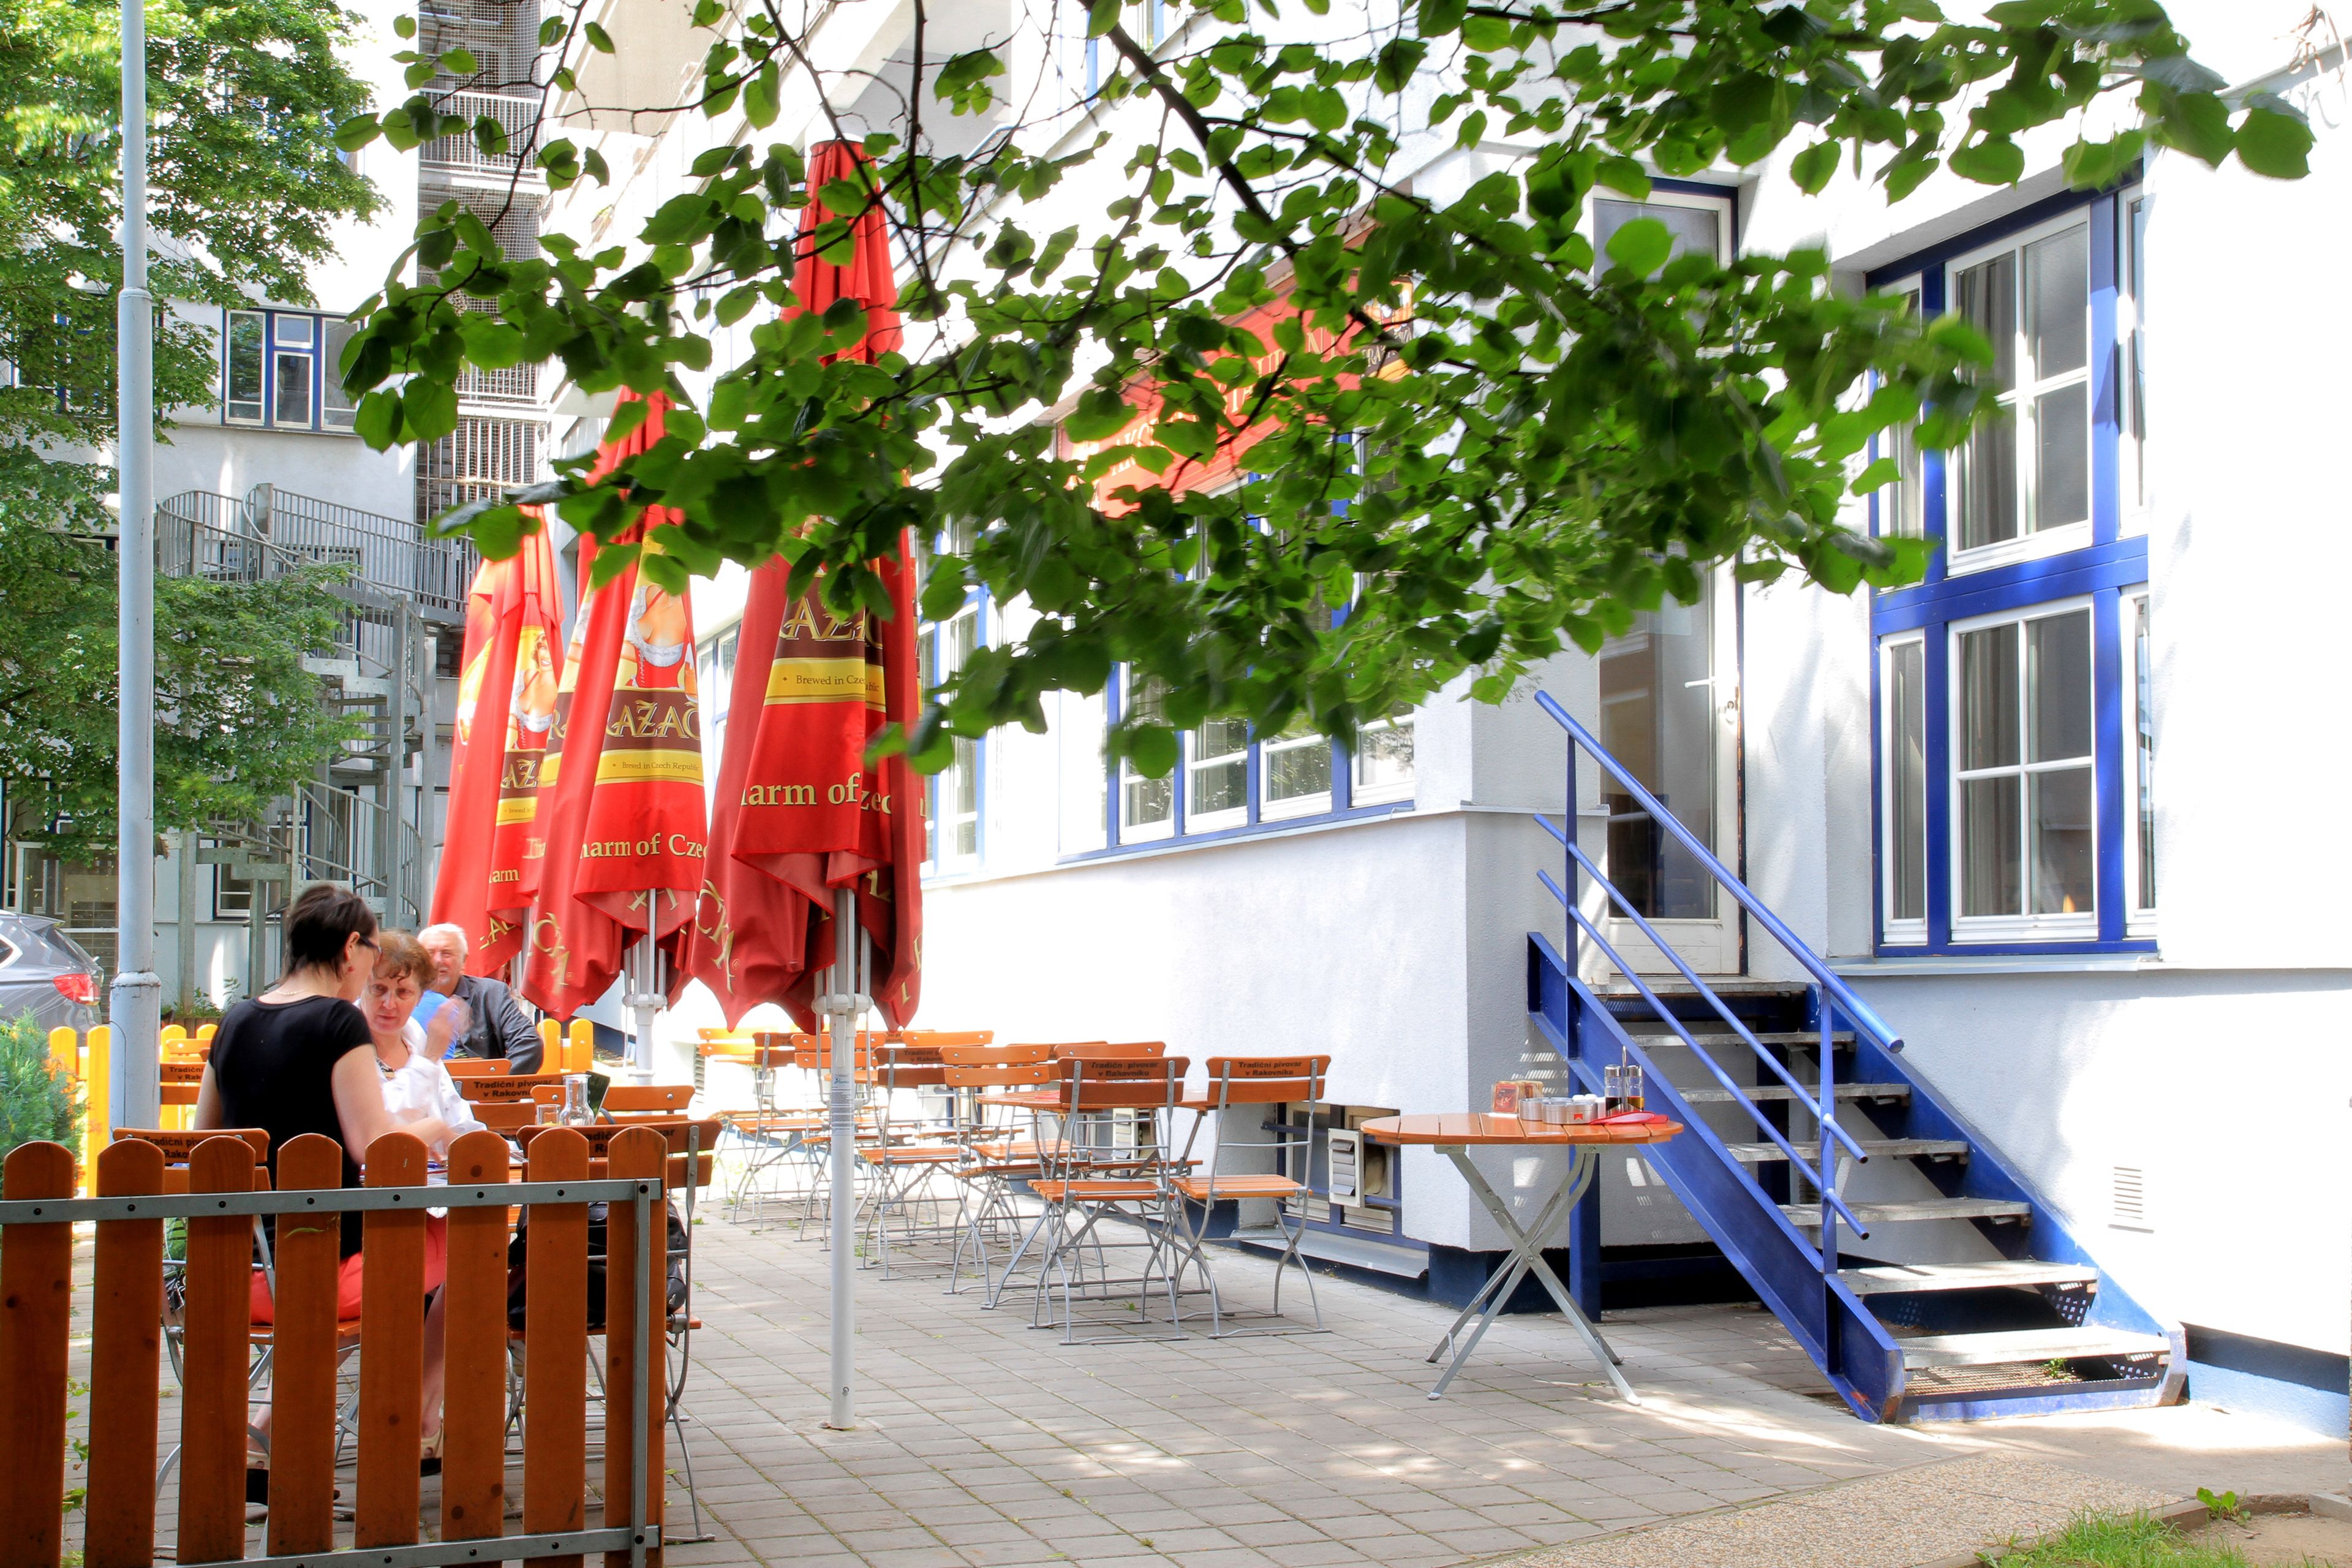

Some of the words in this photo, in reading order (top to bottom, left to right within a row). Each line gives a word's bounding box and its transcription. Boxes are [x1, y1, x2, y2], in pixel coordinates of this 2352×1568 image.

[796, 675, 831, 685] Brewed
[835, 676, 844, 685] in
[846, 674, 866, 684] Cze
[828, 772, 861, 805] of
[636, 832, 662, 856] of
